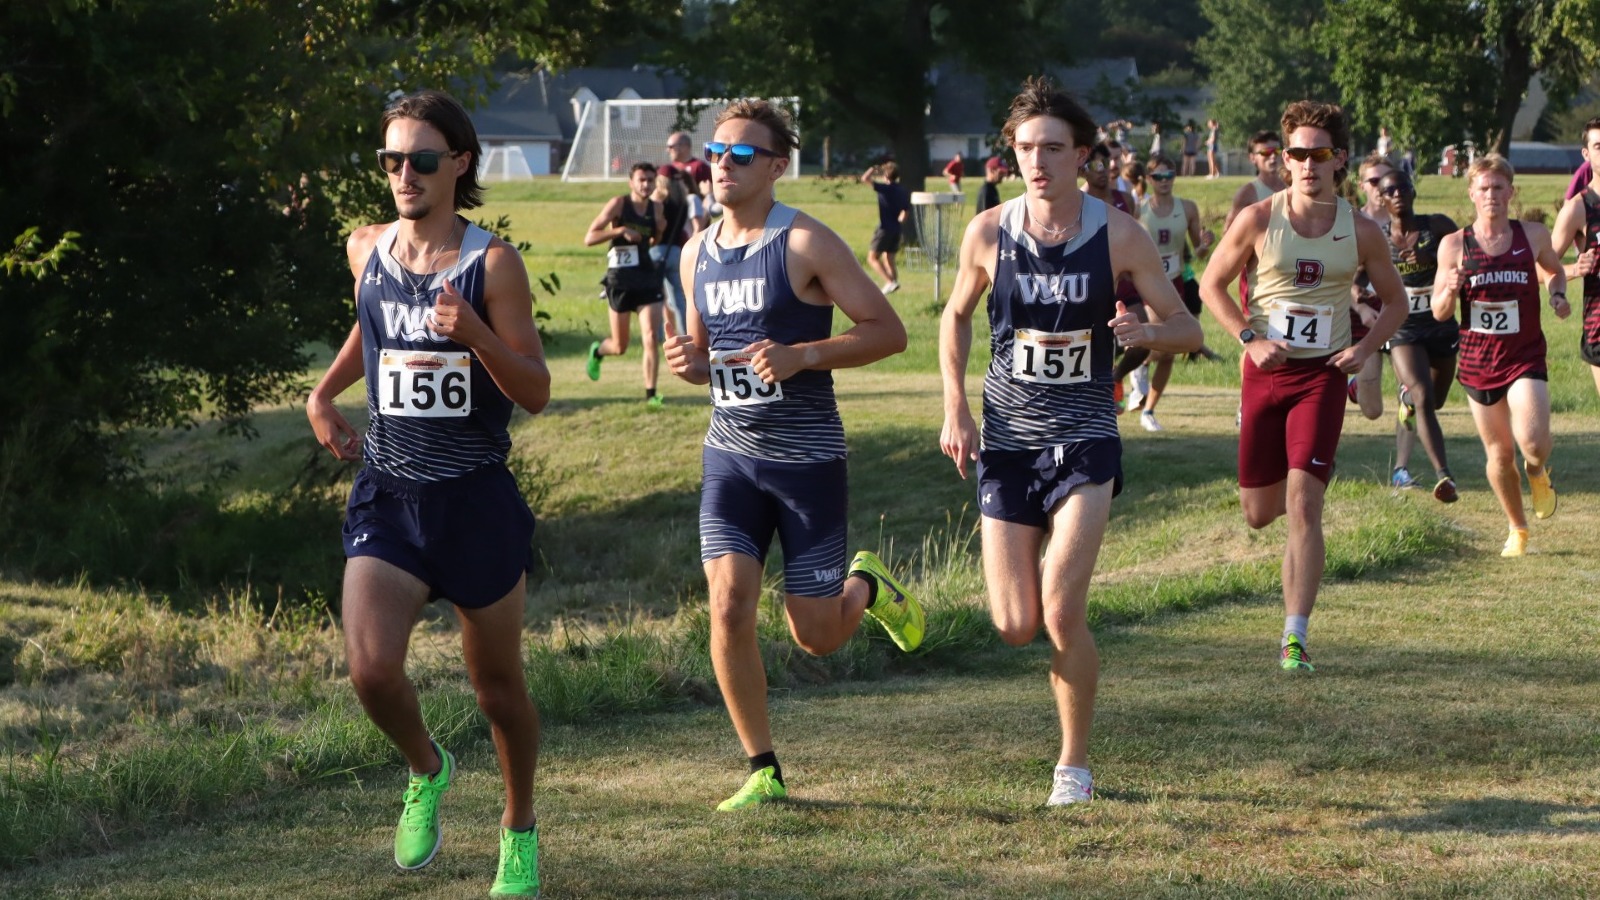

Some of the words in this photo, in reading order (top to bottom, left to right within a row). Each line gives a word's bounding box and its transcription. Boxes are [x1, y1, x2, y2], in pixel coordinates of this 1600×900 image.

[1015, 272, 1091, 305] VWU
[1293, 258, 1325, 288] B
[1470, 271, 1529, 288] ROANOKE
[704, 278, 766, 317] VWU
[1283, 315, 1318, 344] 14
[1480, 312, 1509, 331] 92
[1022, 345, 1088, 379] 157
[388, 370, 467, 411] 156
